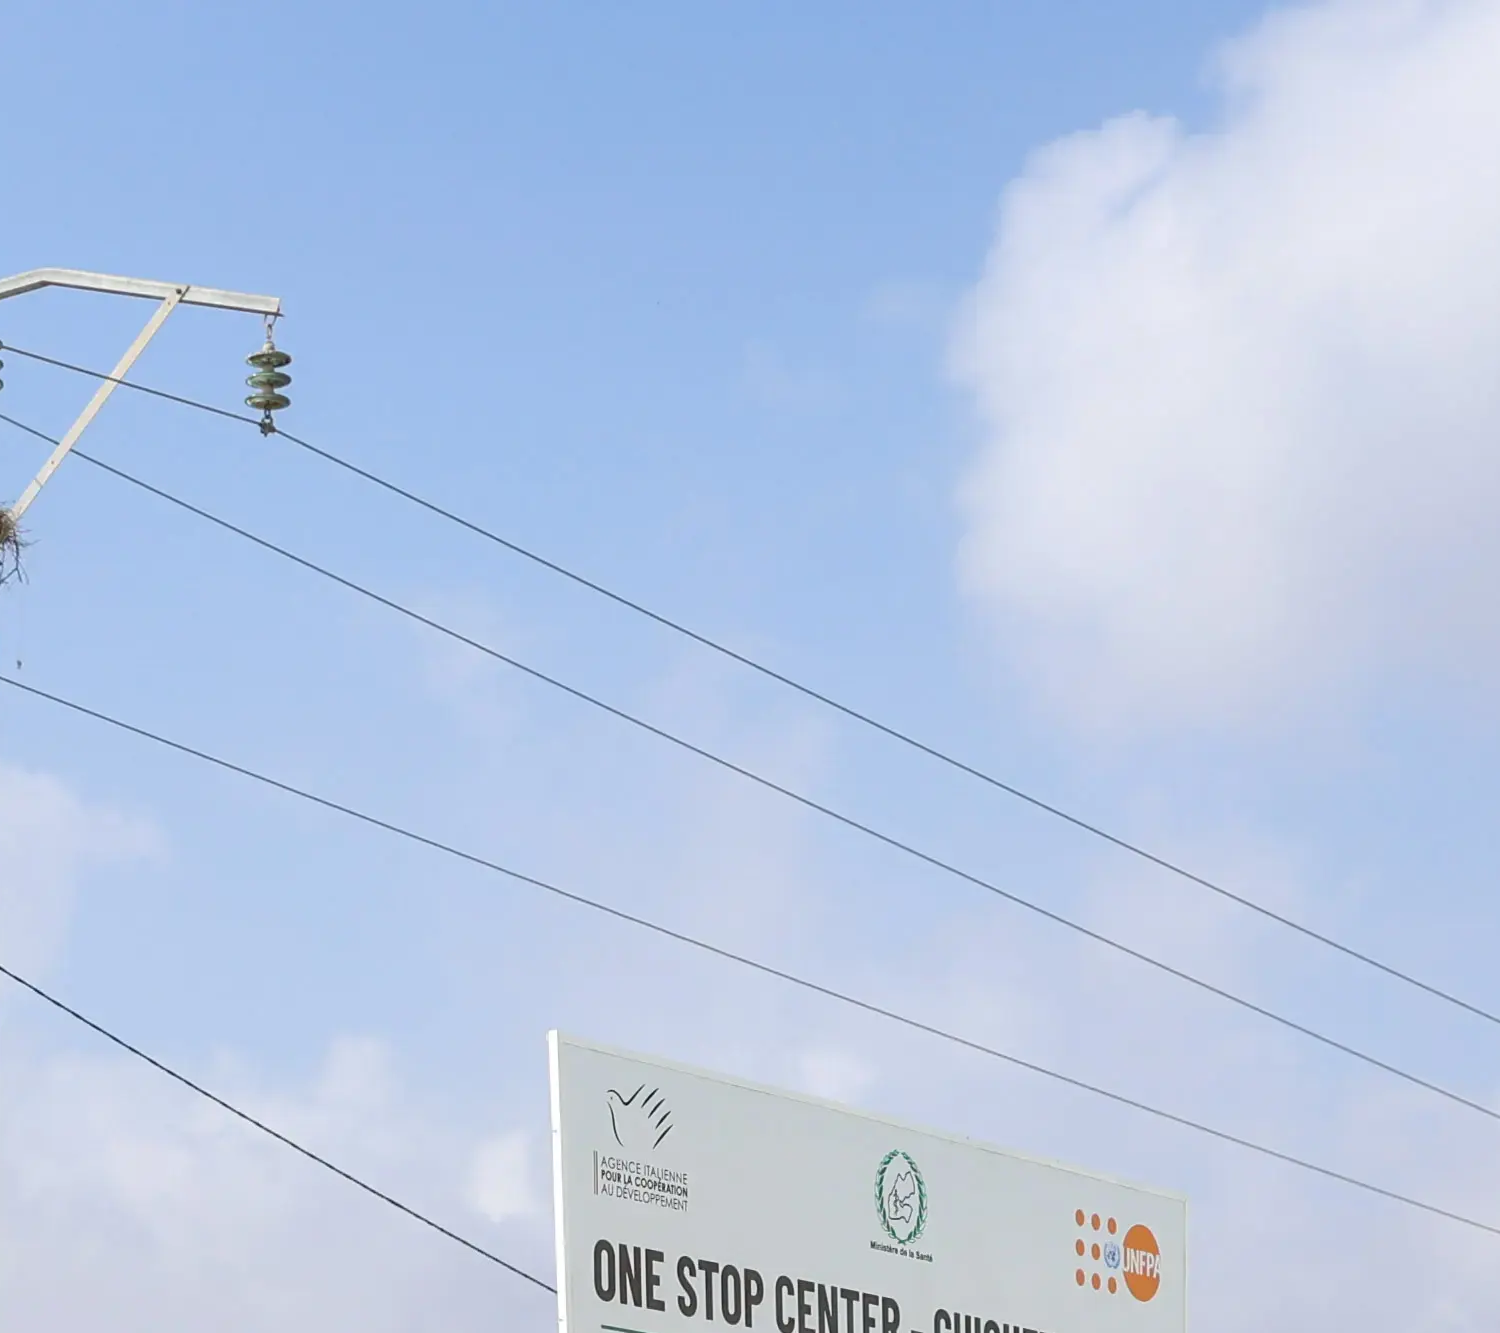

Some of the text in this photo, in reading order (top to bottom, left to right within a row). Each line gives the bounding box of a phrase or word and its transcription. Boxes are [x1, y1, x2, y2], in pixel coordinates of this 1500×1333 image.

[601, 1156, 688, 1186] AGENCE ITALIENNE
[601, 1169, 622, 1183] POUR
[624, 1175, 633, 1186] LA
[601, 1183, 688, 1212] AU DÉVELOPPEMENT
[900, 1248, 908, 1257] de
[1122, 1246, 1161, 1279] UNFPA
[593, 1238, 666, 1312] ONE
[676, 1255, 765, 1329] STOP
